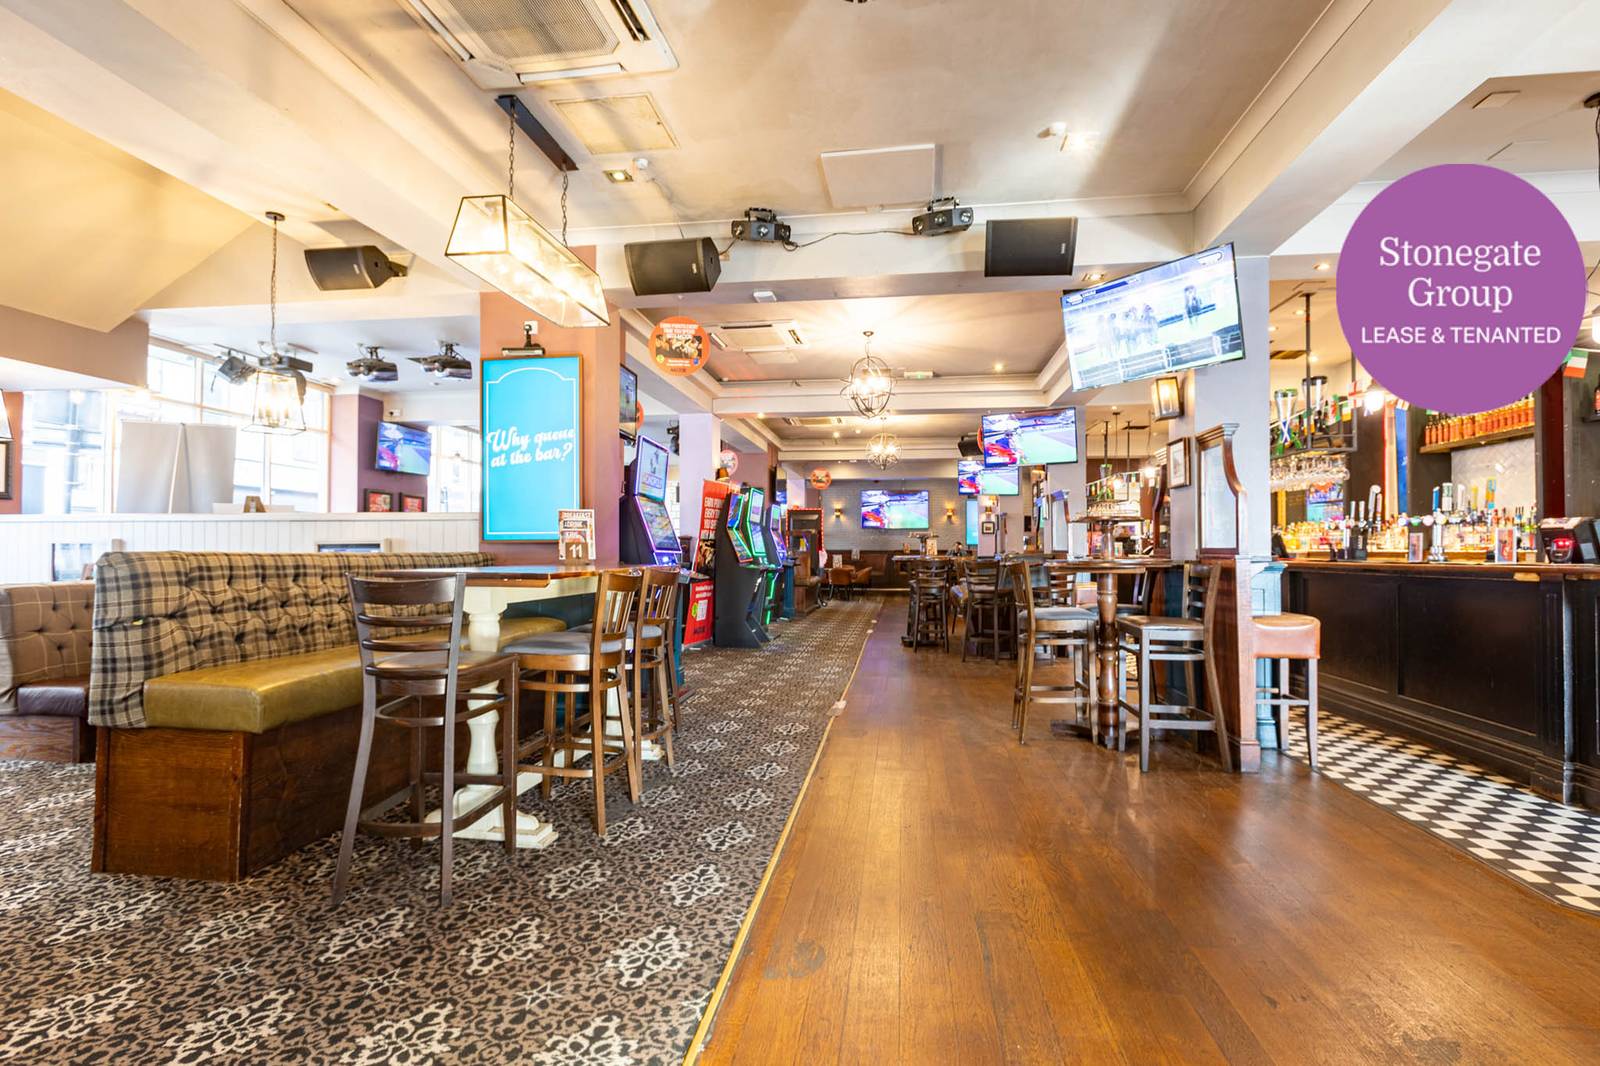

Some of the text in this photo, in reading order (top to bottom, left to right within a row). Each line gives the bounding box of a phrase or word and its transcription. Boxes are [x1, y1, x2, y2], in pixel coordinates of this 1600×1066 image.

[486, 426, 577, 453] Why queue
[490, 442, 573, 468] at the bar?
[569, 544, 583, 558] 11
